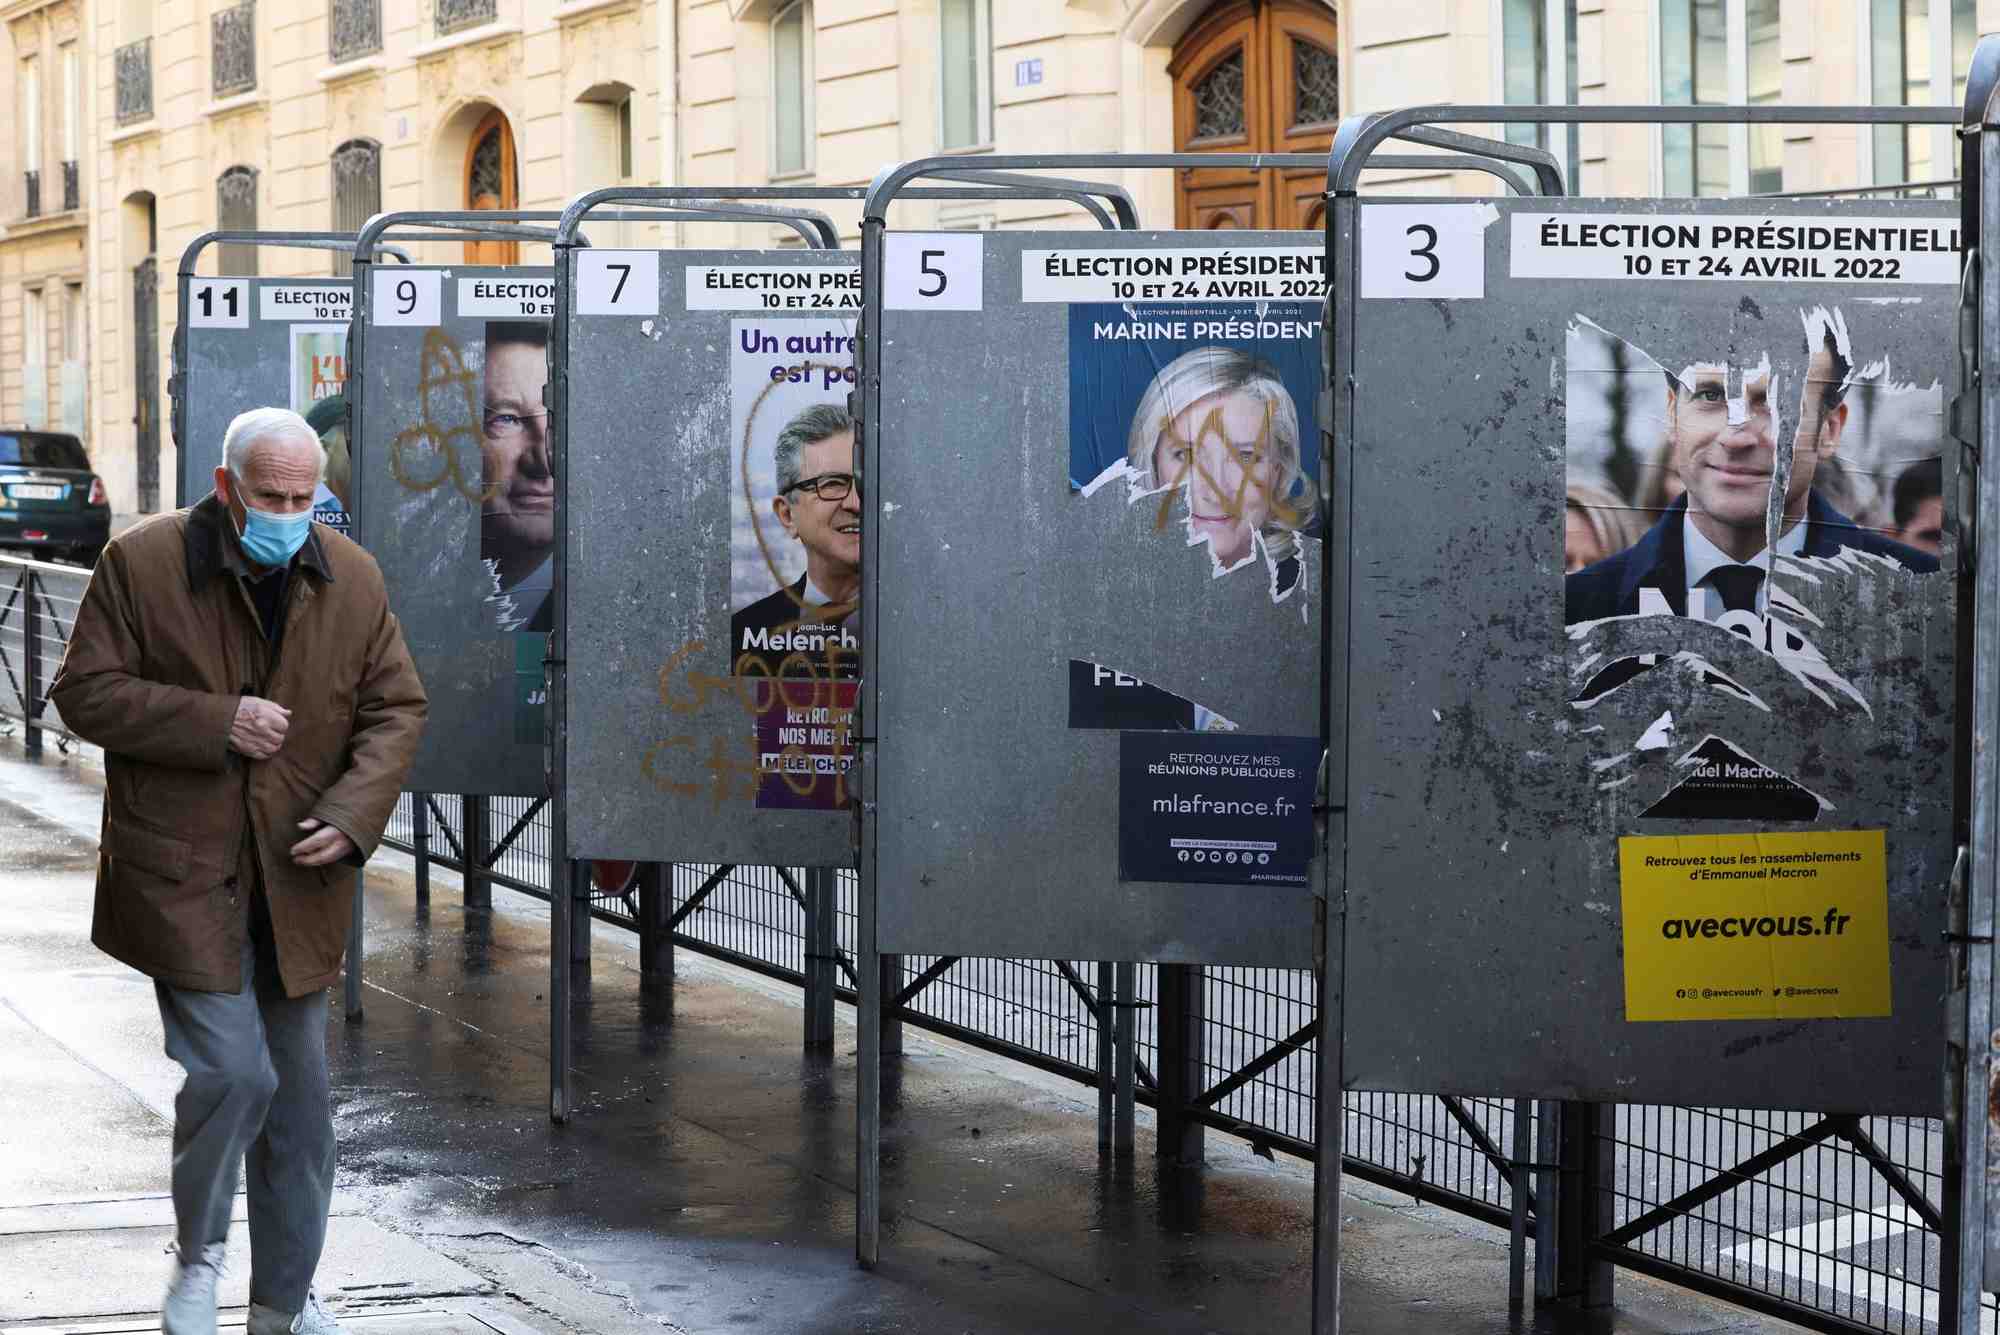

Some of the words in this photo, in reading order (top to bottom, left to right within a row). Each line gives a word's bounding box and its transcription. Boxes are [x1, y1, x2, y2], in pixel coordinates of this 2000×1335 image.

[1541, 217, 1700, 248] ÉLECTION
[1404, 223, 1441, 282] 3
[918, 250, 947, 296] 5
[1045, 253, 1173, 276] ÉLECTION
[1624, 255, 1652, 275] 10
[1661, 259, 1690, 275] ET
[1698, 256, 1733, 276] 24
[1740, 256, 1826, 277] AVRIL
[1834, 258, 1900, 278] 2022
[606, 264, 631, 303] 7
[705, 269, 812, 289] ÉLECTION
[819, 269, 861, 289] PRÉ
[274, 288, 350, 304] ÉLECTION
[396, 280, 417, 315] 9
[1112, 282, 1135, 298] 10
[1142, 284, 1166, 298] ET
[1172, 281, 1199, 298] 24
[1205, 281, 1274, 297] AVRIL
[197, 286, 238, 317] 11
[520, 302, 536, 314] 10
[541, 304, 555, 314] ET
[761, 294, 780, 307] 10
[786, 296, 806, 307] ET
[810, 293, 834, 307] 24
[314, 307, 328, 318] 10
[332, 309, 346, 318] ET
[741, 329, 778, 353] Un
[785, 326, 855, 354] autre
[1093, 321, 1187, 340] MARINE
[770, 360, 810, 383] est
[742, 627, 859, 651] Melench
[779, 728, 806, 745] NOS
[765, 757, 854, 770] MELENCHO
[1169, 753, 1250, 766] RETROUVEZ
[1253, 756, 1281, 766] MES
[1148, 762, 1218, 776] RÉUNIONS
[1221, 766, 1296, 778] PUBLIQUES
[1152, 792, 1296, 817] mlafrance.fr
[1645, 855, 1706, 866] Retrouvez
[1710, 854, 1736, 865] tous
[1740, 853, 1757, 865] les
[1760, 851, 1862, 864] rassemblements
[1689, 868, 1767, 881] d'Emmanuel
[1771, 867, 1817, 879] Macron
[1662, 907, 1850, 939] avecvous.fr
[1702, 987, 1763, 999] @avecvousfr
